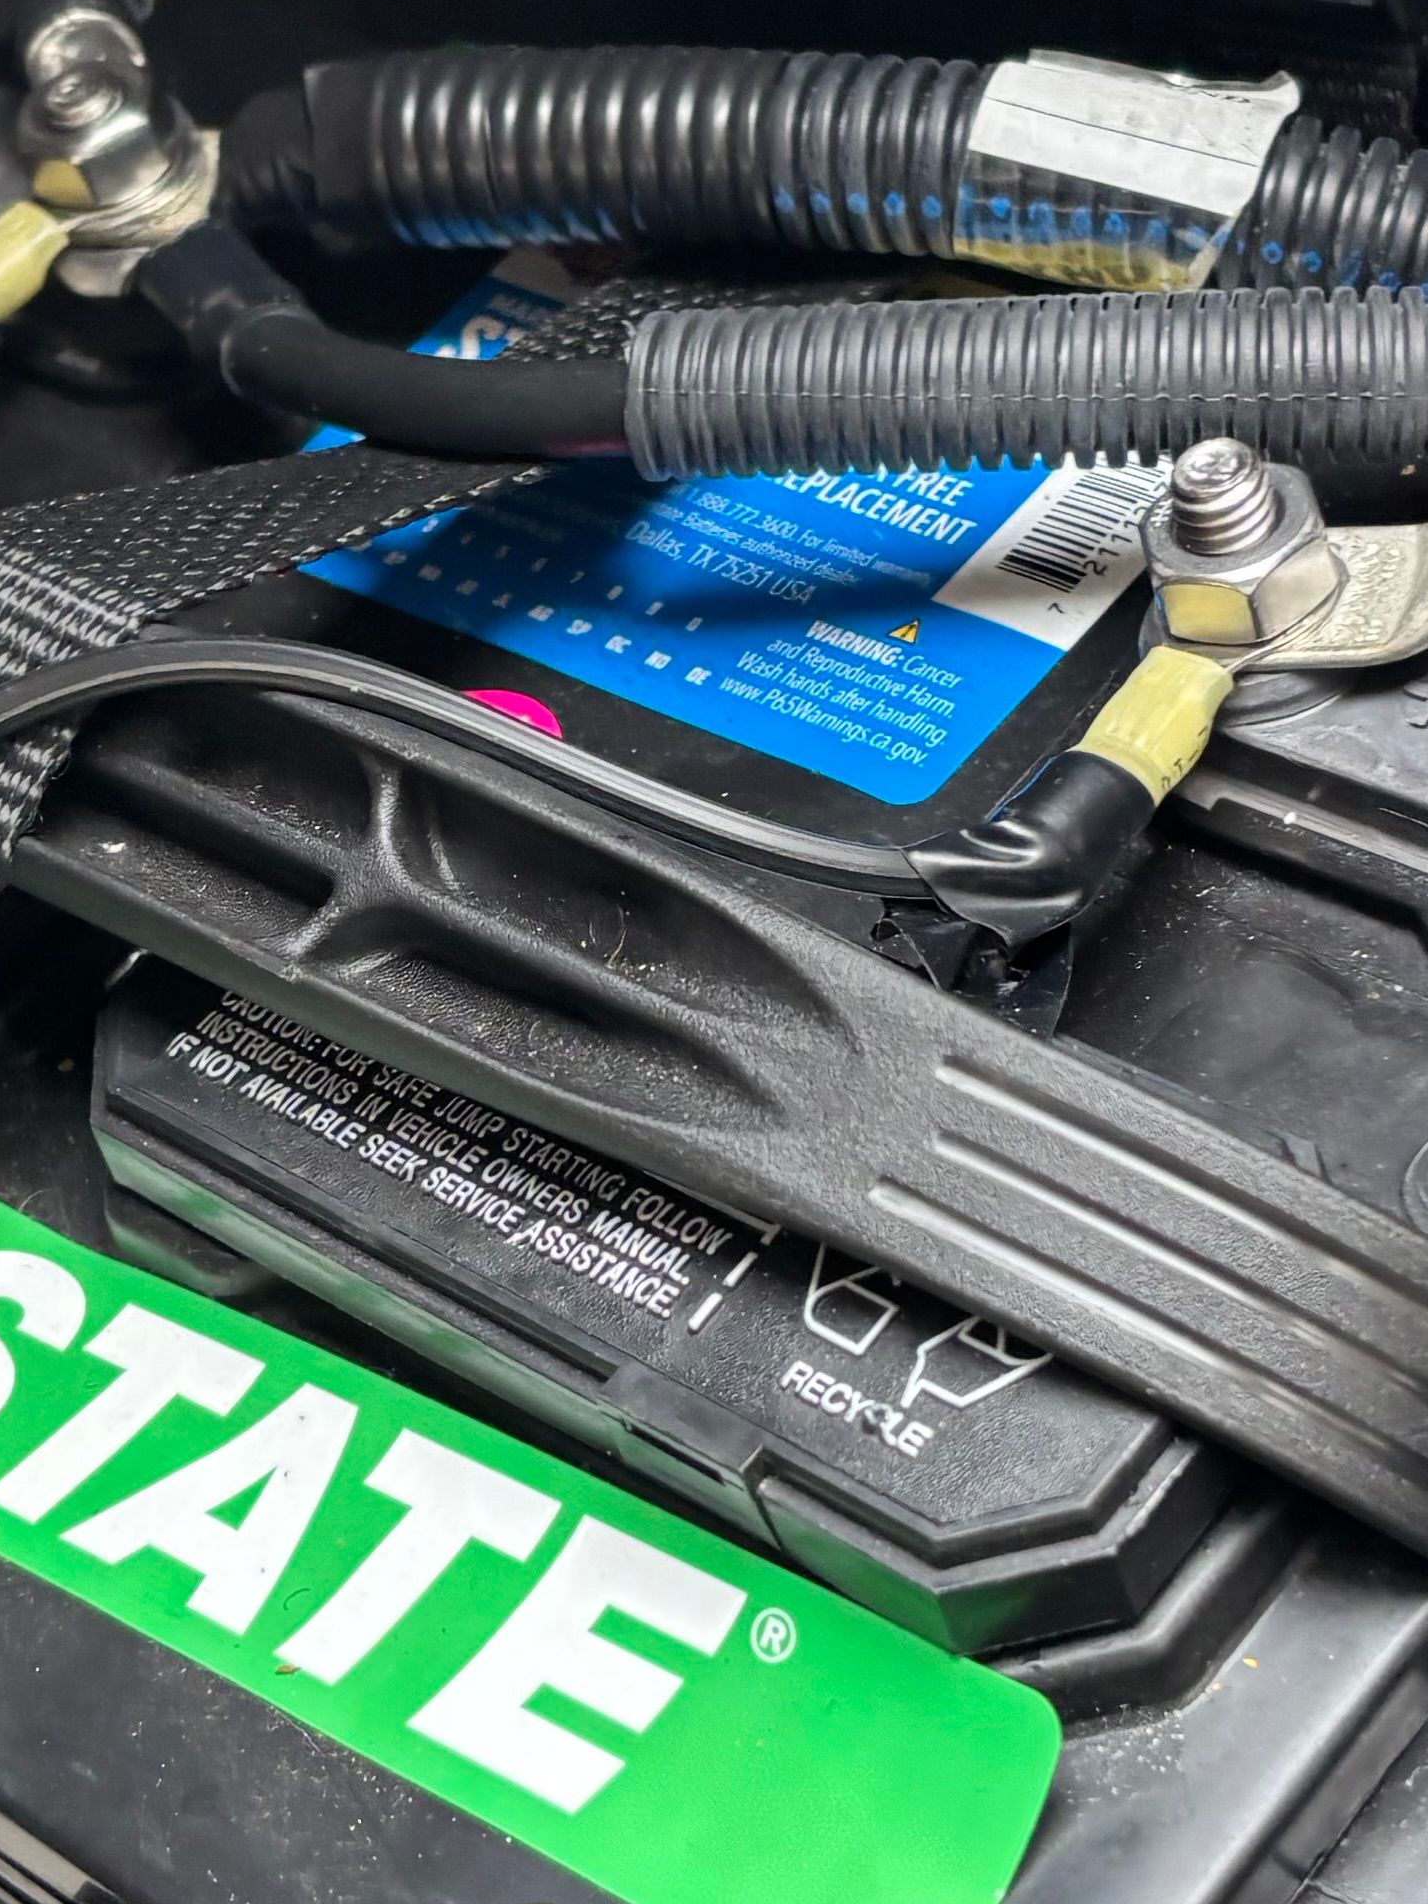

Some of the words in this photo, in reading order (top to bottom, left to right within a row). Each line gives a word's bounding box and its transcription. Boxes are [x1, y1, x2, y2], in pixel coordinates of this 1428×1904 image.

[773, 466, 977, 545] EPLACEMENT
[892, 457, 975, 507] FREE
[624, 519, 684, 561] Dallas,
[686, 543, 721, 567] TX
[710, 554, 774, 590] 75251
[768, 575, 818, 606] USA
[735, 649, 787, 681] Wash
[782, 666, 835, 700] hands
[829, 686, 872, 714] after
[867, 698, 948, 749] handling.
[765, 638, 805, 661] and
[801, 647, 910, 698] Reproductive
[902, 685, 958, 720] Harm.
[805, 618, 905, 669] WARNING:
[901, 654, 965, 690] Cancer
[195, 1010, 360, 1106] INSTRUCTIONS
[354, 1091, 392, 1124] IN
[386, 1106, 490, 1174] VEHICLE
[481, 1156, 591, 1225] OWNERS
[586, 1208, 692, 1286] MANUAL.
[221, 989, 322, 1052] CAUTION:
[322, 1040, 375, 1077] FOR
[372, 1063, 442, 1109] SAFE
[433, 1095, 507, 1139] JUMP
[502, 1125, 628, 1205] STARTING
[621, 1186, 734, 1256] FOLLOW
[165, 1030, 202, 1059] IF
[189, 1045, 252, 1087] NOT
[239, 1072, 368, 1150] AVAILABLE
[358, 1131, 429, 1183] SEEK
[421, 1164, 526, 1234] SERVICE
[518, 1217, 681, 1320] ASSISTANCE.
[779, 1359, 936, 1460] RECYCLE
